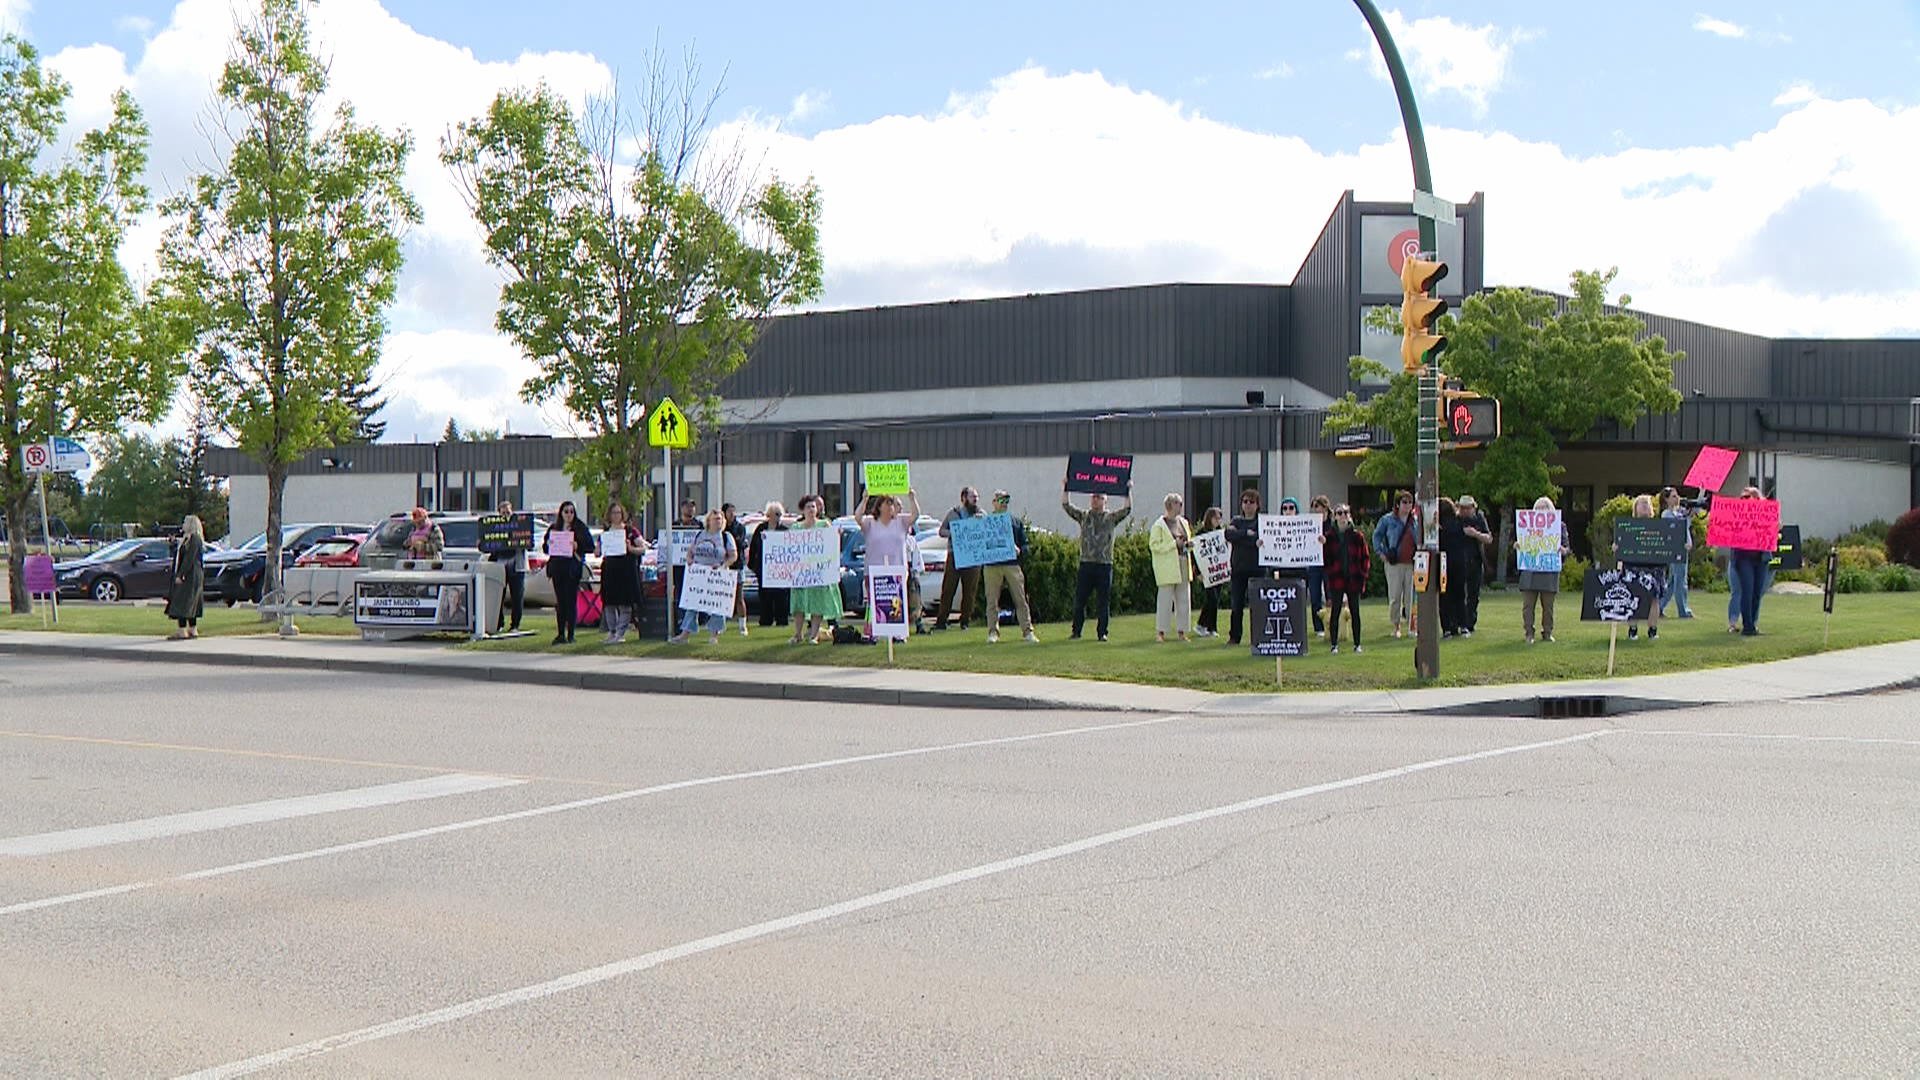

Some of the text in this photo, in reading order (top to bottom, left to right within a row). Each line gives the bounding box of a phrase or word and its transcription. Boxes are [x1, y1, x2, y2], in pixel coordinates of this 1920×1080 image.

[1106, 458, 1130, 469] LEGACY
[482, 516, 511, 525] LEGACY
[1266, 520, 1313, 528] RE-BRANDING
[1518, 511, 1556, 529] STOP
[1200, 535, 1220, 548] JUST
[771, 544, 824, 556] EDUCATION
[1208, 555, 1219, 565] TO
[1260, 588, 1296, 600] LOCK
[1269, 602, 1288, 613] UP
